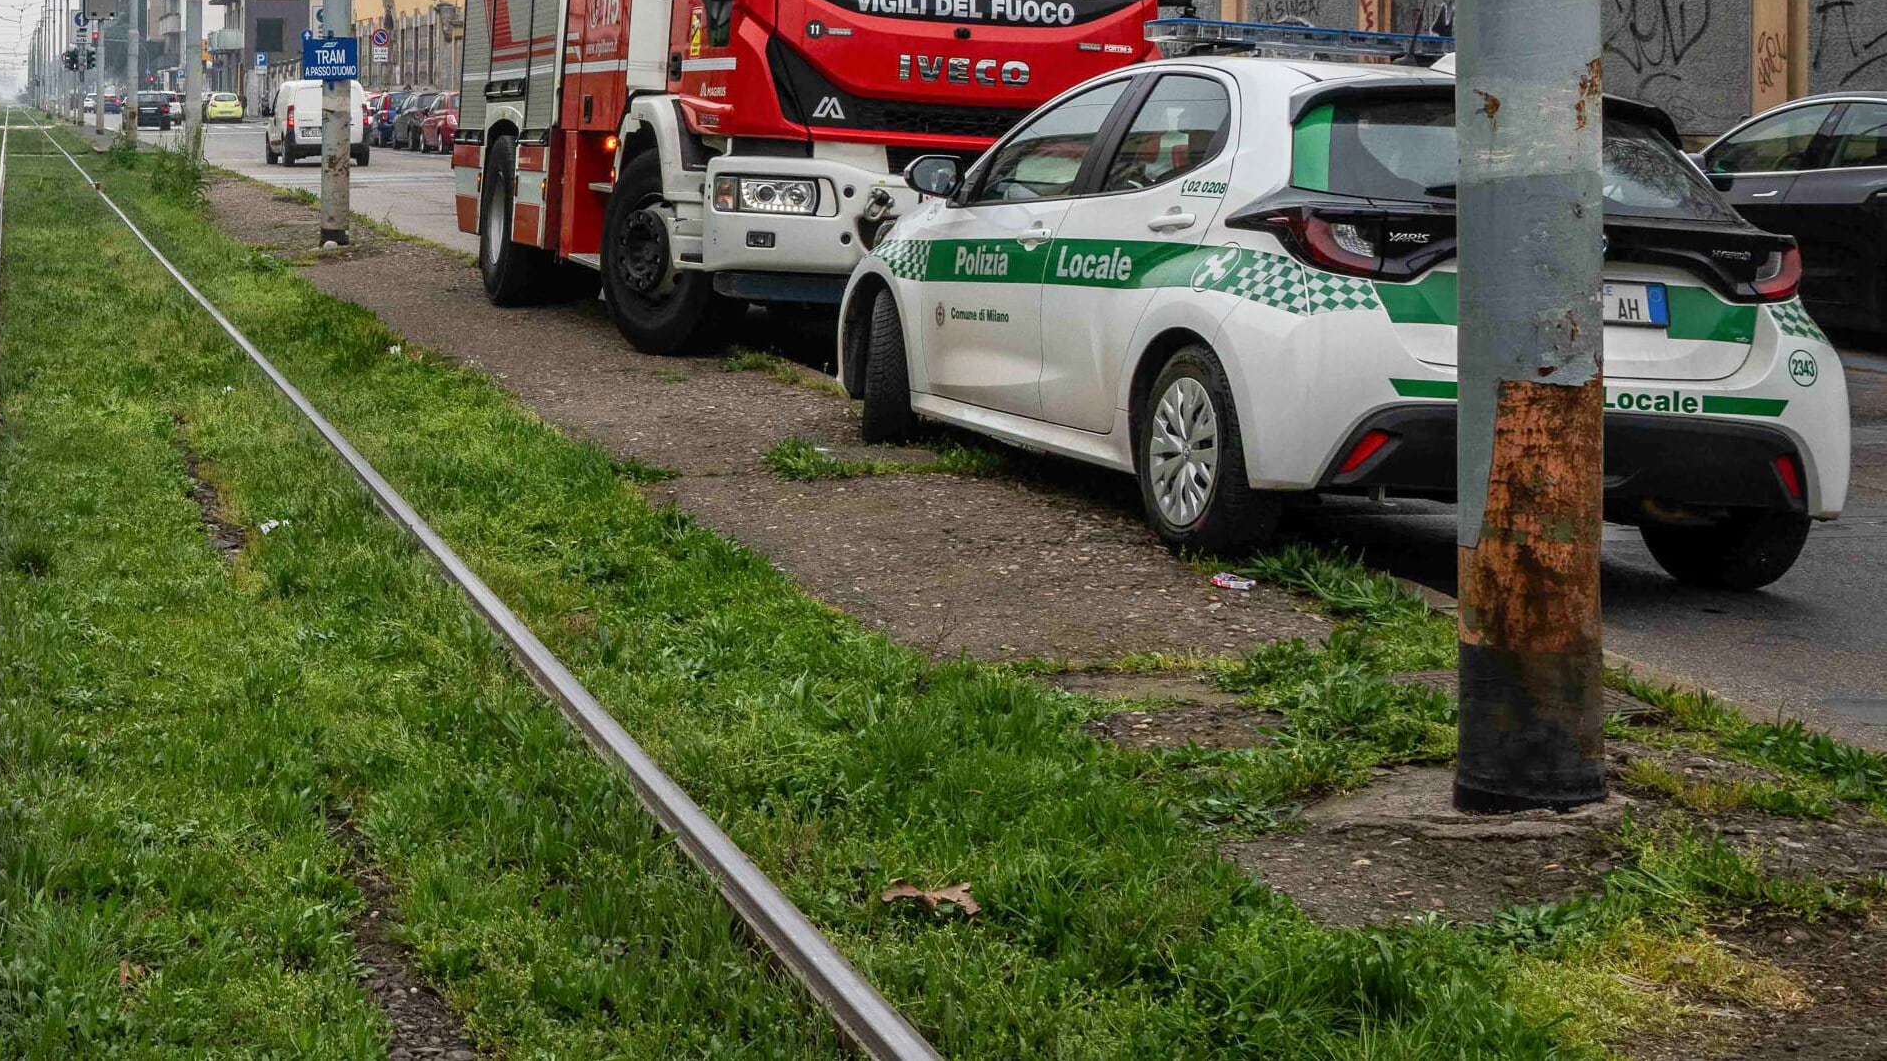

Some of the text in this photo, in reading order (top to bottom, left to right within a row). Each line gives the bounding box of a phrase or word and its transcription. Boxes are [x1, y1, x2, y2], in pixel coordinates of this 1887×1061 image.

[810, 24, 820, 35] 11
[315, 49, 346, 65] TRAM
[305, 65, 356, 77] A PASSO D'UOMO
[899, 54, 1030, 87] IVECO
[1188, 181, 1227, 194] 02 0208
[1389, 232, 1430, 244] YARIS
[954, 245, 1132, 281] Polizia Locale
[951, 307, 1009, 323] Comune di Milano
[1618, 297, 1640, 321] AH
[1792, 358, 1815, 377] 2343
[1603, 386, 1698, 414] Locale
